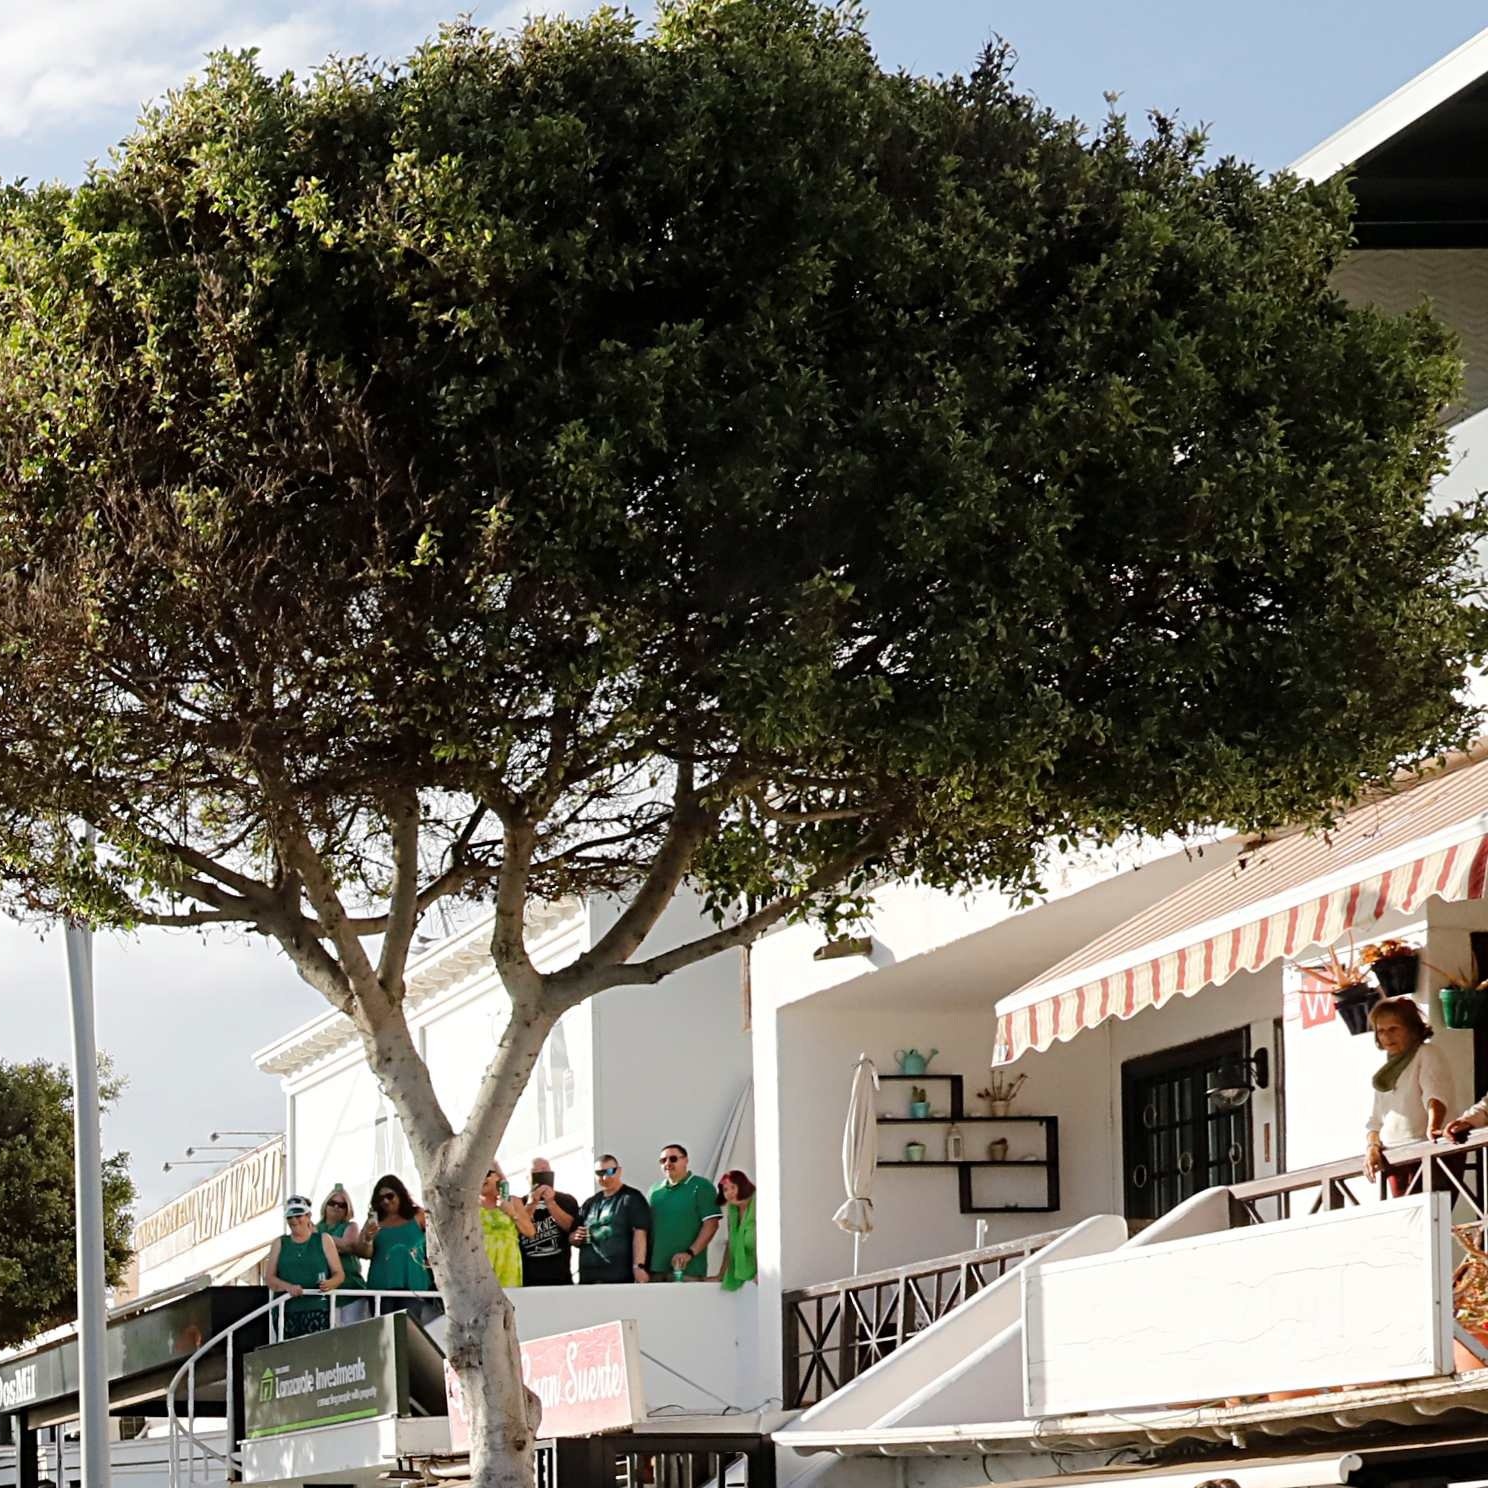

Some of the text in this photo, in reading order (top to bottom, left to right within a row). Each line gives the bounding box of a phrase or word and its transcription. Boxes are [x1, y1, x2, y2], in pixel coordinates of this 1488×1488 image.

[228, 1148, 282, 1230] WORLD
[315, 1356, 366, 1391] Investments
[565, 1341, 623, 1405] Suerte
